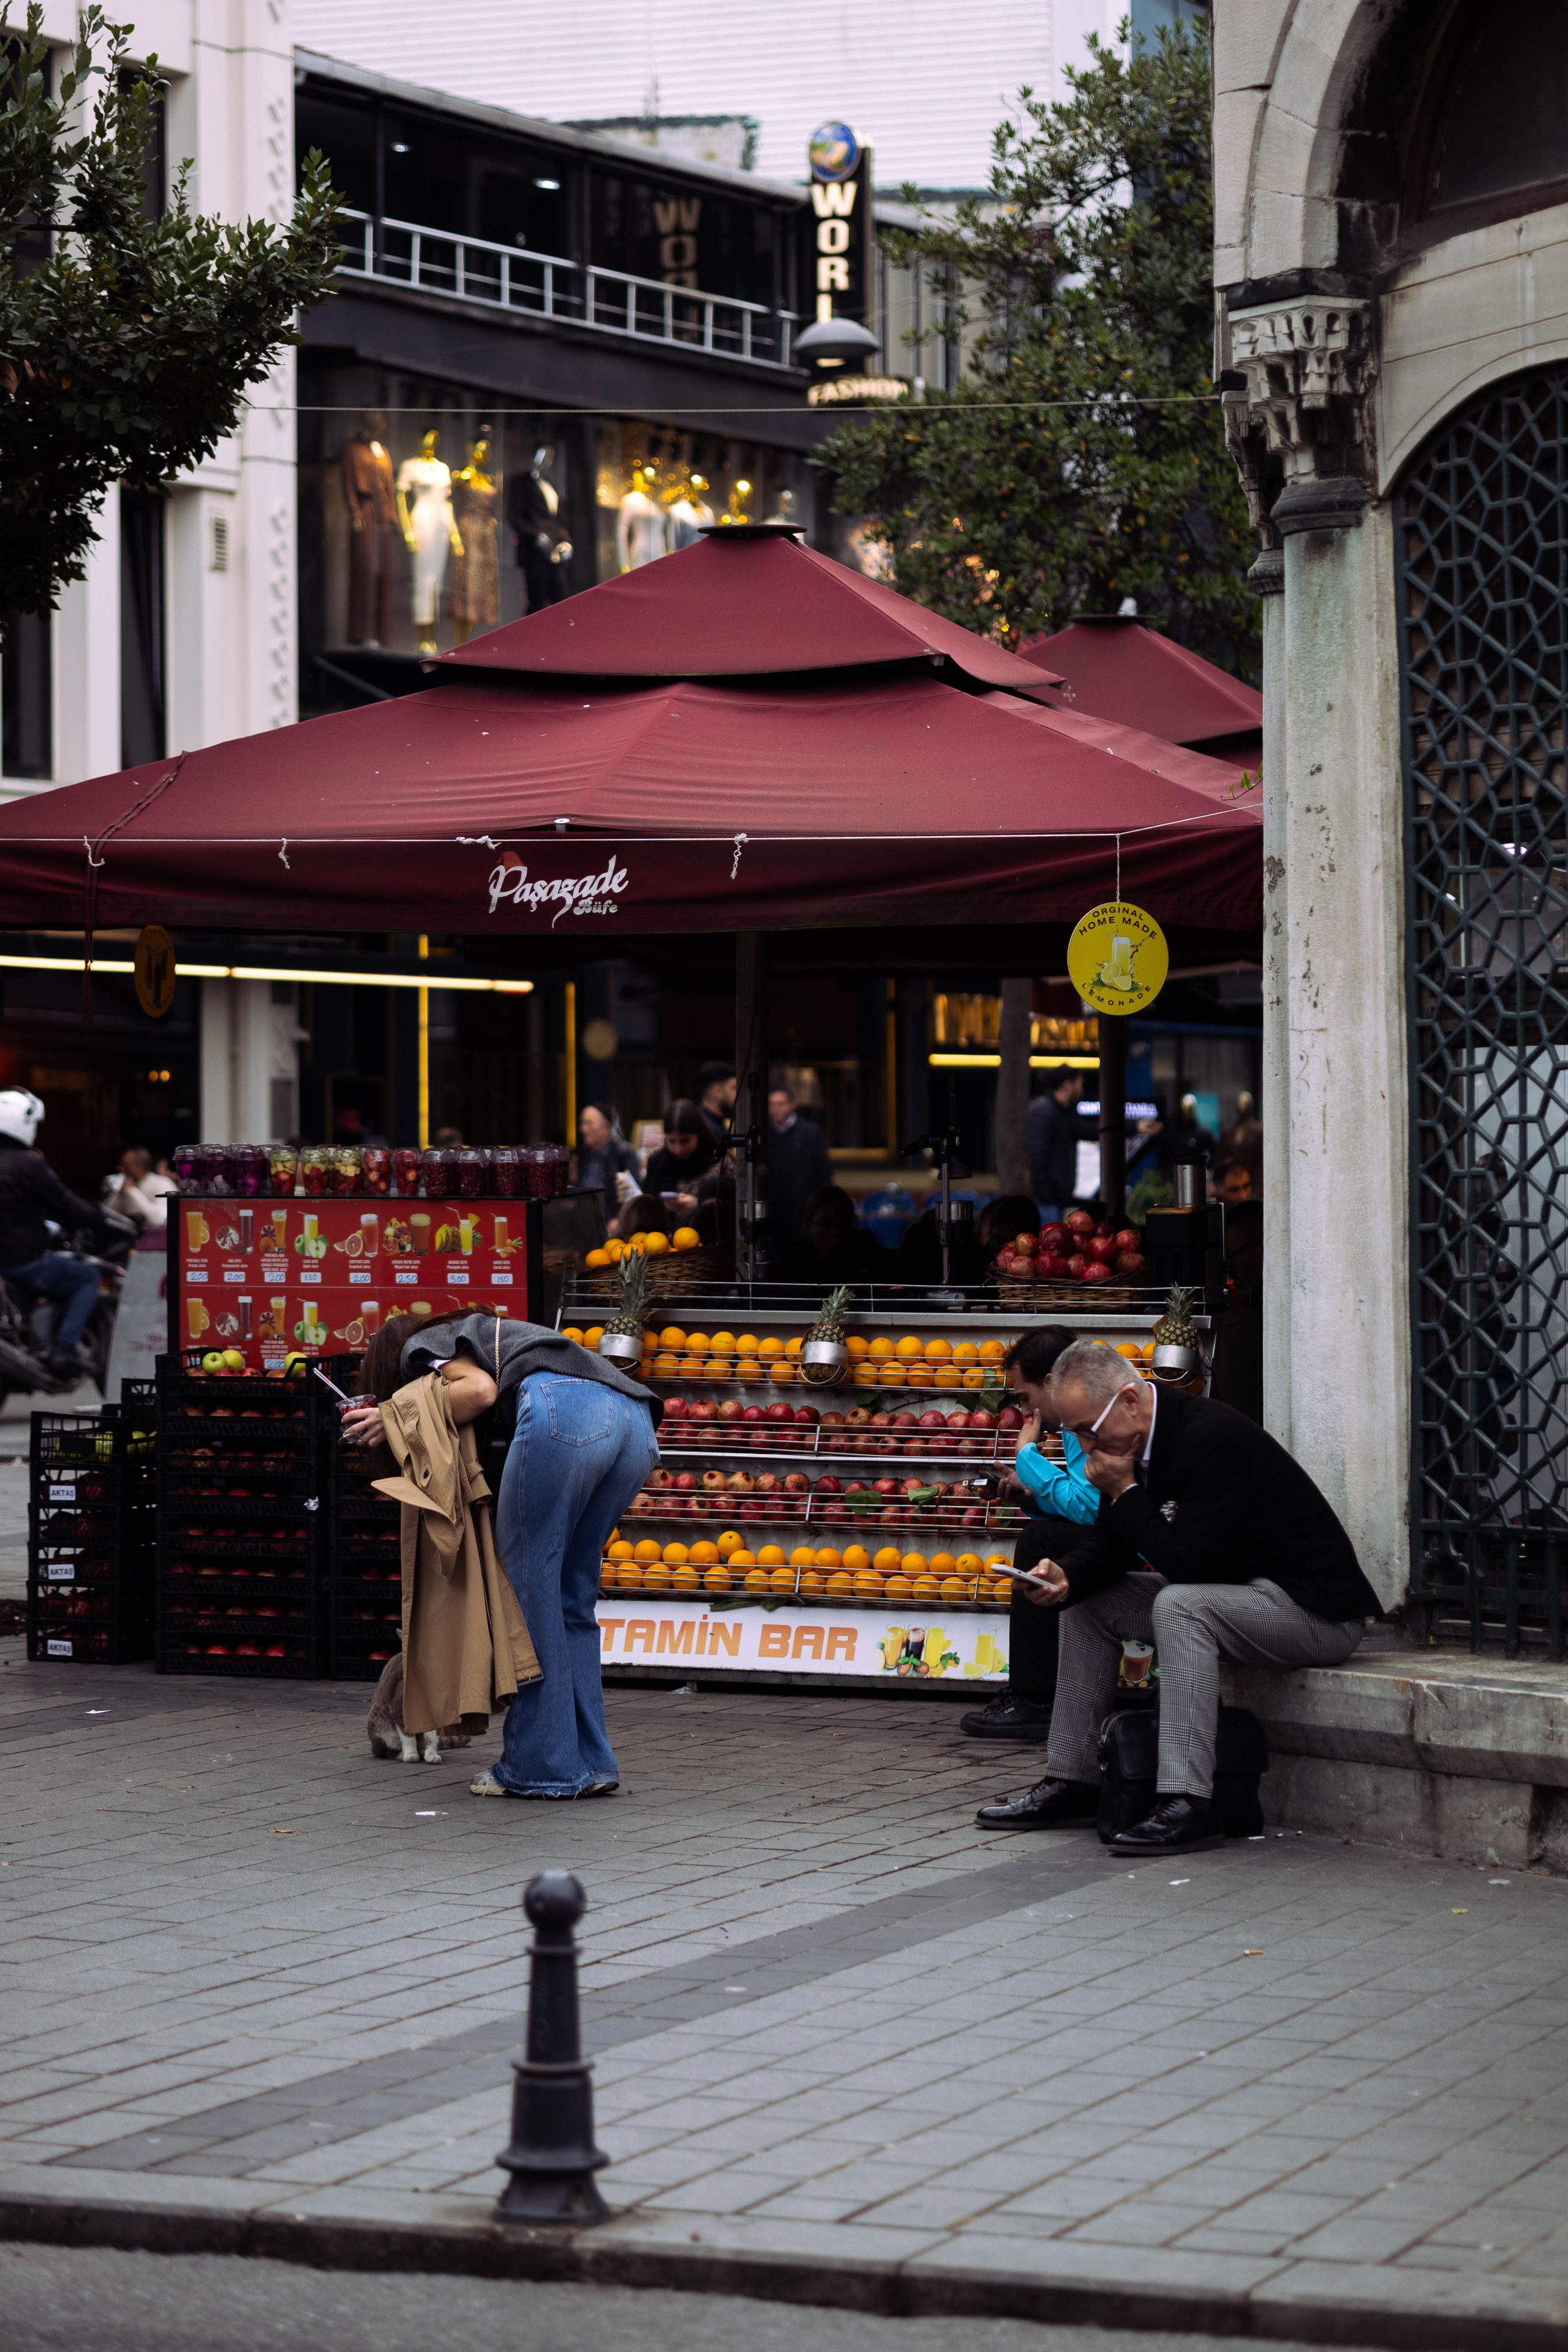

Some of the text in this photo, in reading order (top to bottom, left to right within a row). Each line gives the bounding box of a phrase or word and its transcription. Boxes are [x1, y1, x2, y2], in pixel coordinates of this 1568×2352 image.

[488, 854, 629, 929] Paşazade
[573, 897, 618, 916] Büfe
[1092, 907, 1144, 921] ORGINAL
[1079, 916, 1158, 939] HOME MADE
[1082, 982, 1152, 1006] LEMONADE
[191, 1272, 208, 1281] 200
[268, 1273, 285, 1281] 200
[398, 1274, 417, 1283] 250
[450, 1275, 466, 1283] 300
[758, 1623, 859, 1662] BAR
